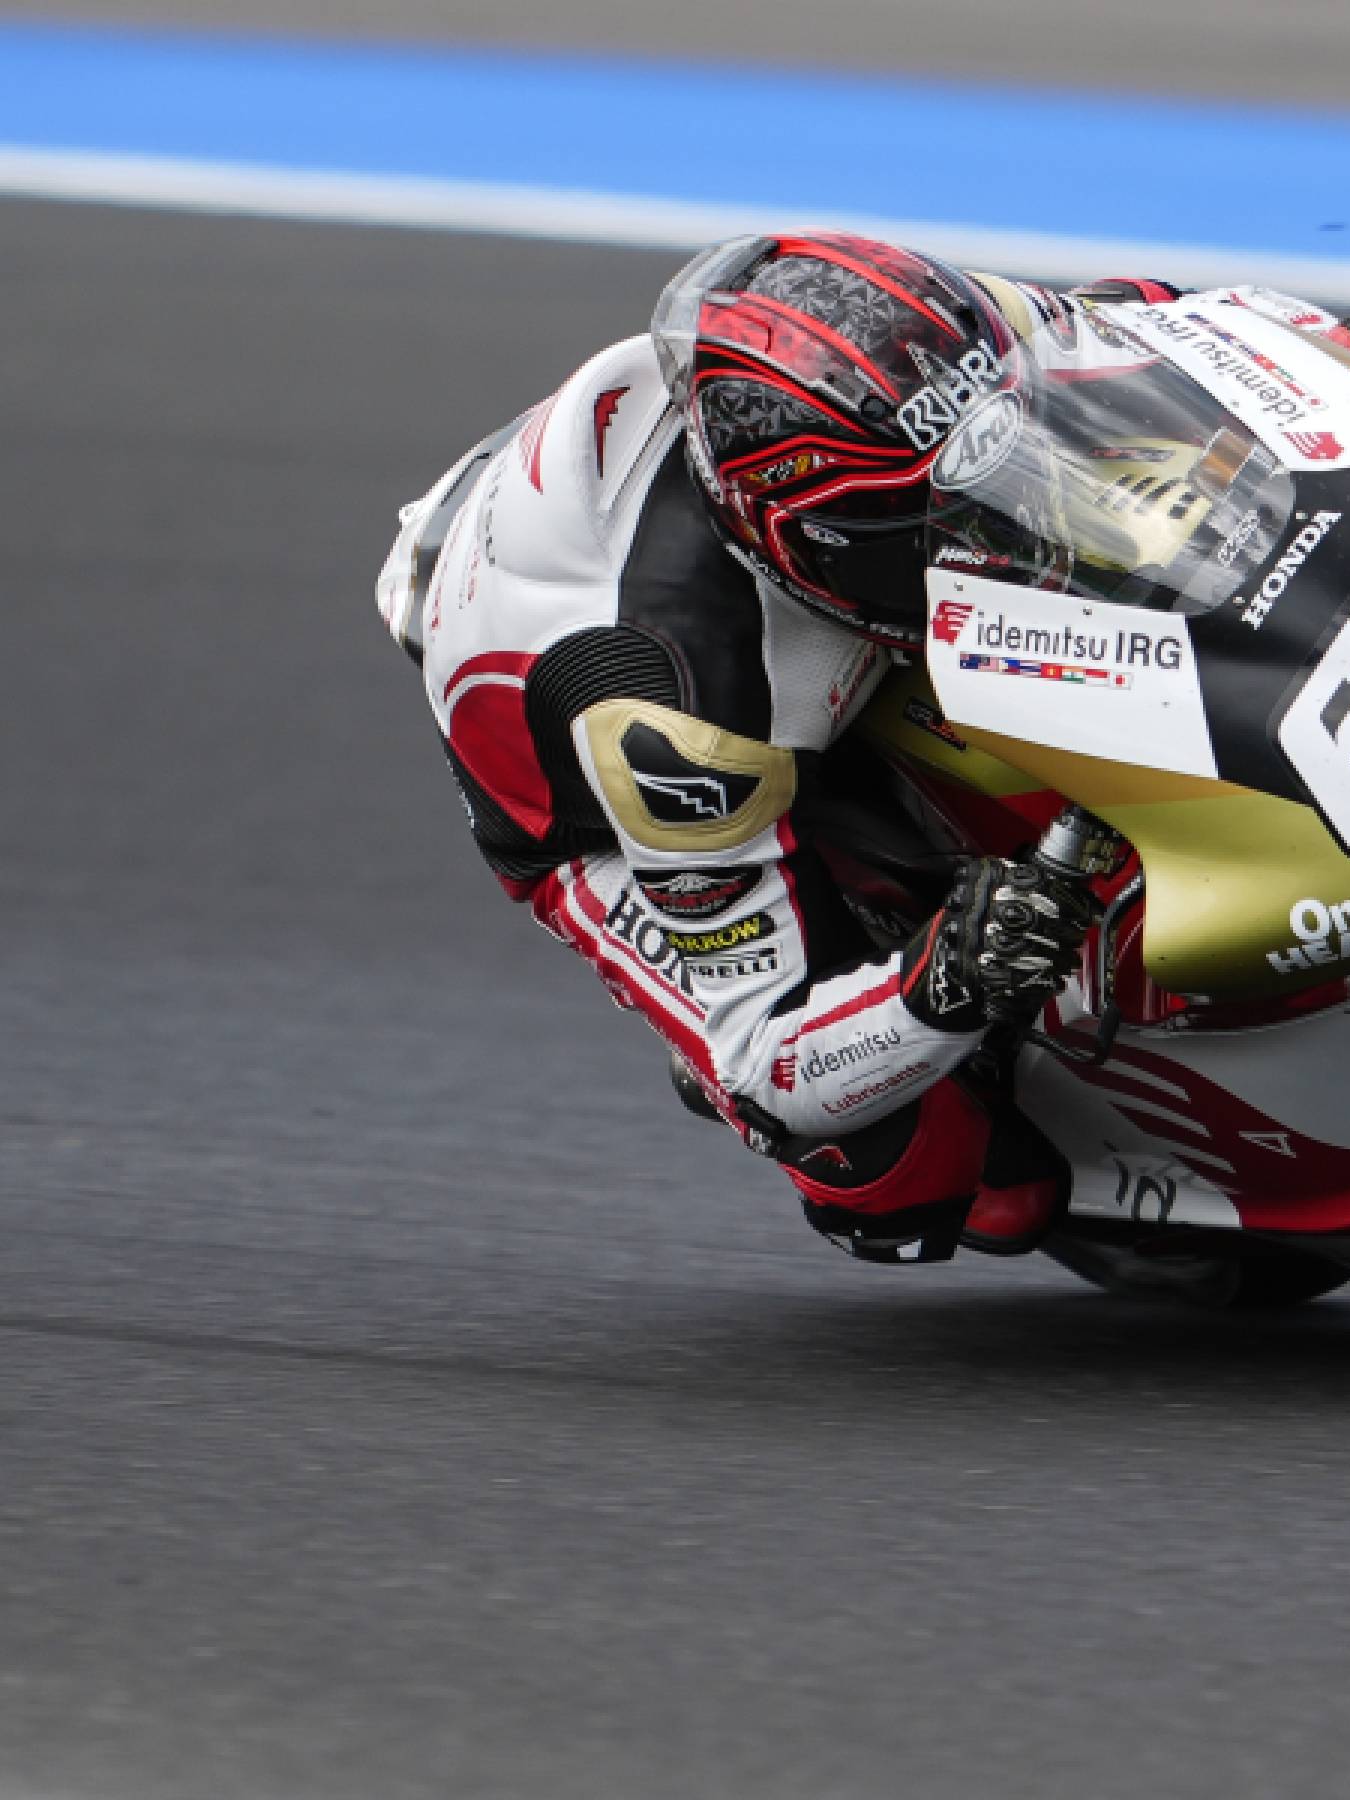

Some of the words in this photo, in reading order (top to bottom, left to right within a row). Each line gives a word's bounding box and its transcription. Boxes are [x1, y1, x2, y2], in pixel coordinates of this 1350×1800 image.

[1241, 511, 1342, 630] HONDA
[977, 612, 1106, 663] idemitsu
[1115, 632, 1183, 671] IRG
[801, 1027, 902, 1082] idemitsu
[822, 1061, 931, 1115] Lubricants
